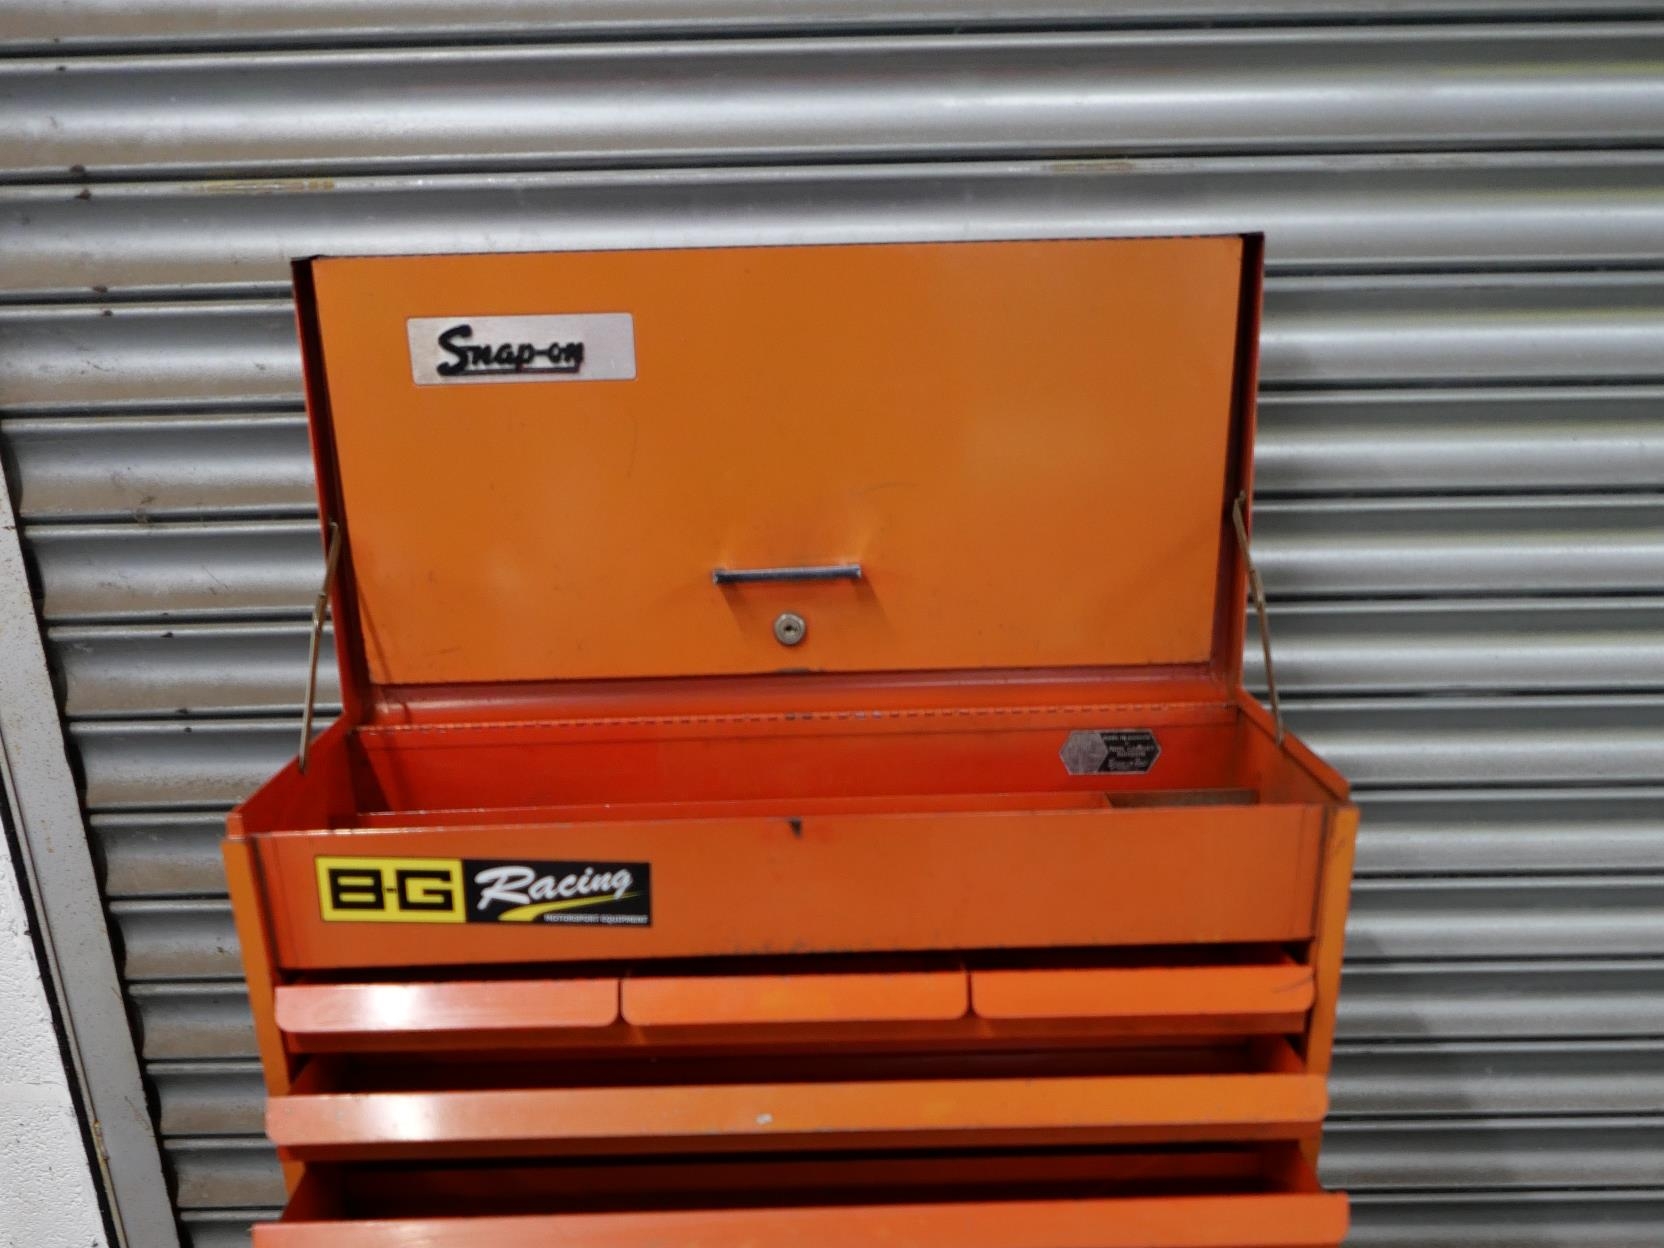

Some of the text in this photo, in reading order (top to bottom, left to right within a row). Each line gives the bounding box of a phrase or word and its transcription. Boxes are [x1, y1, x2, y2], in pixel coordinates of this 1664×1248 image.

[437, 323, 585, 377] Snap-on
[474, 865, 634, 911] Racing
[601, 914, 648, 925] EQUIPMENT
